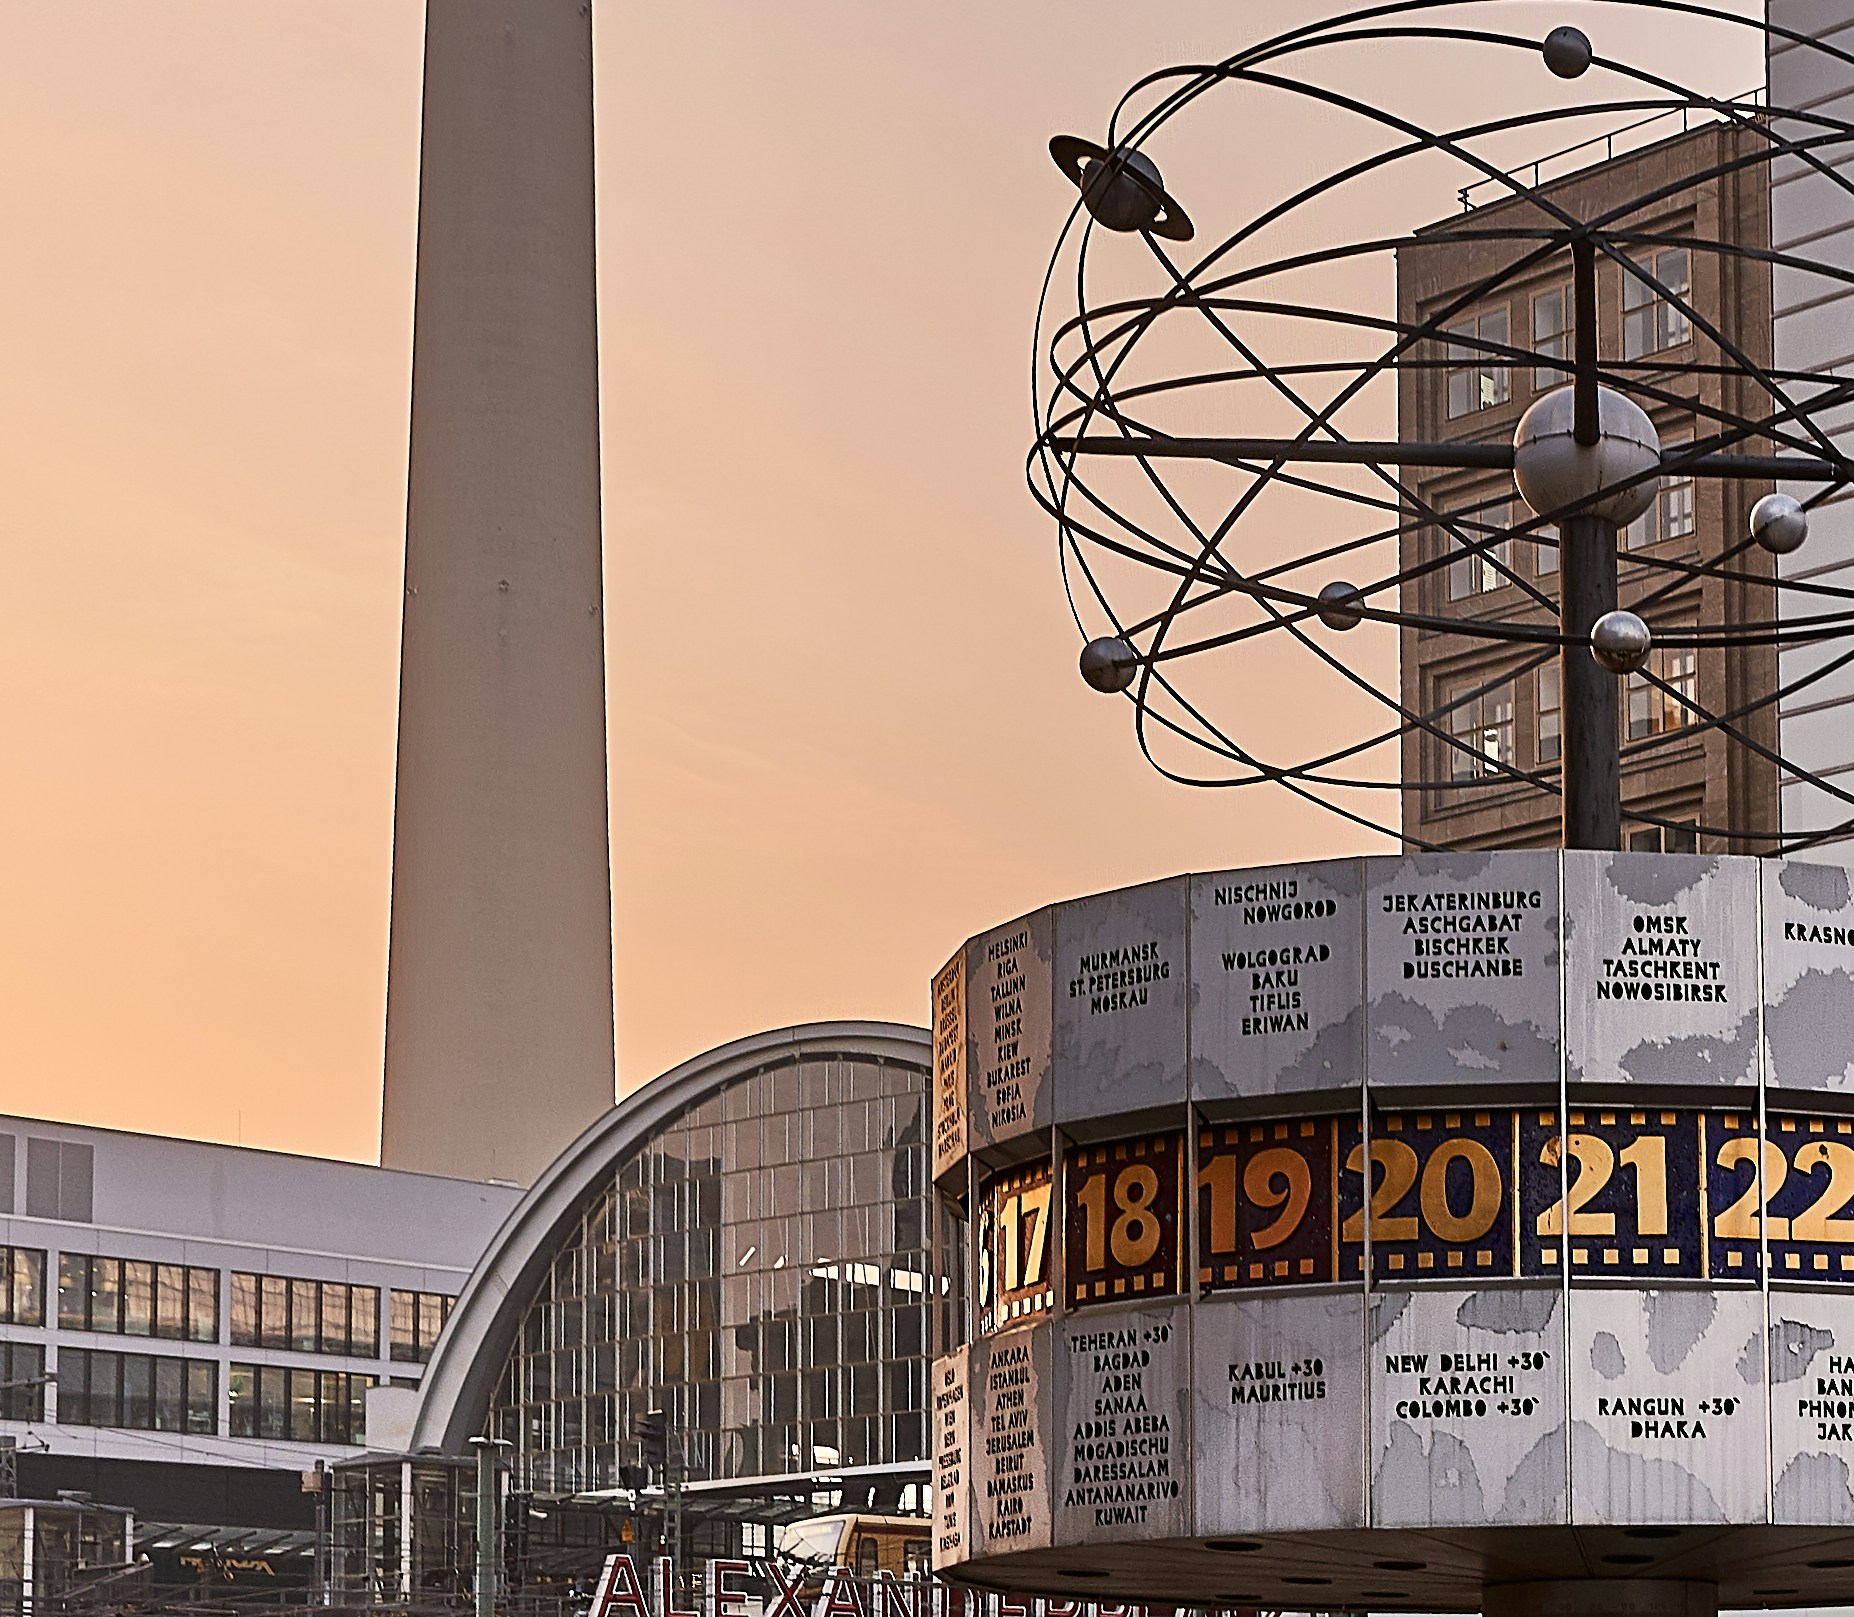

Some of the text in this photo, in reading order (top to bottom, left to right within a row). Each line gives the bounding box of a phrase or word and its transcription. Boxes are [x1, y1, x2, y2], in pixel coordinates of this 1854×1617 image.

[1215, 881, 1297, 906] NISCHNIJ
[1383, 891, 1541, 912] JEKATERINBURG
[1244, 900, 1336, 925] NOWGOROD
[1403, 914, 1522, 935] ASCHGABAT
[1633, 915, 1688, 934] OMSK
[1080, 942, 1158, 974] MURMANSK
[1222, 945, 1330, 971] WOLGOGRAD
[1415, 937, 1510, 956] BISCHKEK
[1621, 937, 1701, 957] ALMATY
[1070, 961, 1169, 998] ST. PETERSBURG
[1252, 969, 1298, 990] BAKU
[1404, 959, 1522, 979] DUSCHANBE
[1603, 959, 1720, 980] TASCHKENT
[991, 974, 1025, 1003] TALLINN
[1597, 980, 1727, 1003] NOWOSIBIRSK
[1091, 987, 1147, 1015] MOSKAU
[1250, 991, 1301, 1013] TIFLIS
[1242, 1012, 1308, 1035] ERIWAN
[987, 1057, 1031, 1089] BUKAREST
[992, 1102, 1026, 1129] NIKOSIA
[1344, 1138, 1502, 1244] 20
[1537, 1133, 1667, 1236] 21
[1198, 1147, 1312, 1254] 19
[1077, 1164, 1160, 1272] 18
[1000, 1183, 1052, 1291] 17
[1071, 1329, 1137, 1353] TEHERAN
[988, 1345, 1029, 1370] ANKARA
[1094, 1350, 1150, 1373] BAGDAD
[1386, 1354, 1428, 1373] NEW
[1441, 1353, 1497, 1372] DELHI
[990, 1366, 1030, 1391] ISTANBUL
[1229, 1358, 1323, 1382] KABUL +30
[1102, 1372, 1141, 1394] ADEN
[1232, 1381, 1325, 1404] MAURITIUS
[1420, 1376, 1513, 1395] KARACHI
[996, 1388, 1024, 1412] ATHEN
[1095, 1393, 1147, 1417] SANAA
[1396, 1399, 1486, 1419] COLOMBO
[1599, 1398, 1684, 1416] RANGUN
[991, 1409, 1028, 1433] TEL AVIV
[1073, 1414, 1170, 1441] ADDIS ABEBA
[1631, 1421, 1706, 1438] DHAKA
[986, 1429, 1034, 1456] JERUSALEM
[1074, 1436, 1169, 1458] MOGADISCHU
[995, 1453, 1024, 1475] BEIRUT
[1074, 1459, 1169, 1484] DARESSALAM
[987, 1473, 1033, 1499] DAMASKUS
[1065, 1480, 1178, 1507] ANTANANARIVO
[997, 1497, 1023, 1519] KAIRO
[1095, 1505, 1147, 1526] KUWAIT
[989, 1515, 1032, 1540] KAPSTADT
